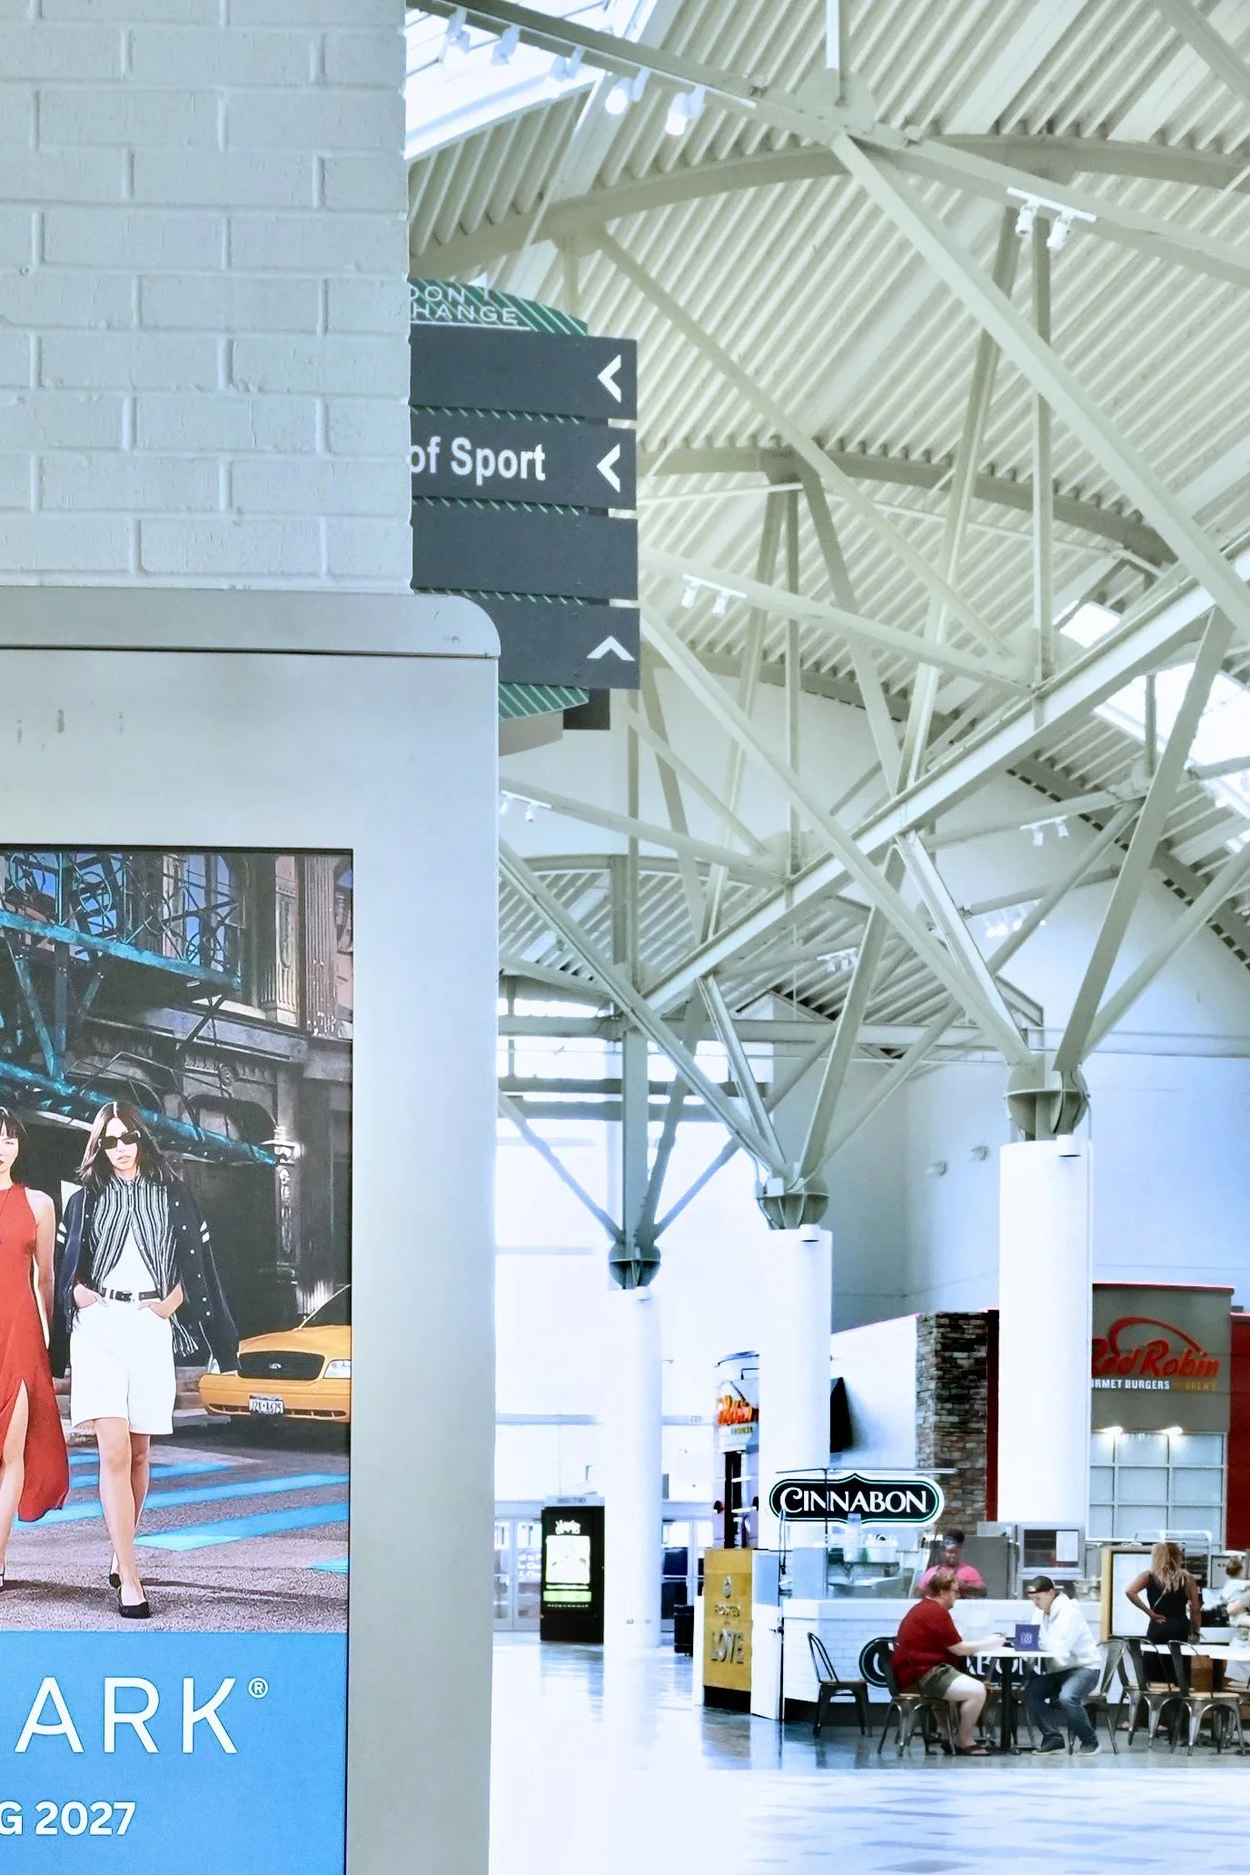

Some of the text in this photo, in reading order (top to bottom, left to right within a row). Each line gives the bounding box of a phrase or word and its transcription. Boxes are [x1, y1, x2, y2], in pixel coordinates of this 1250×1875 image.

[450, 436, 546, 486] Sport
[1139, 1338, 1222, 1378] Robin
[1124, 1380, 1170, 1391] BURGERS
[780, 1487, 927, 1514] CINNABON
[34, 1800, 137, 1836] 2027
